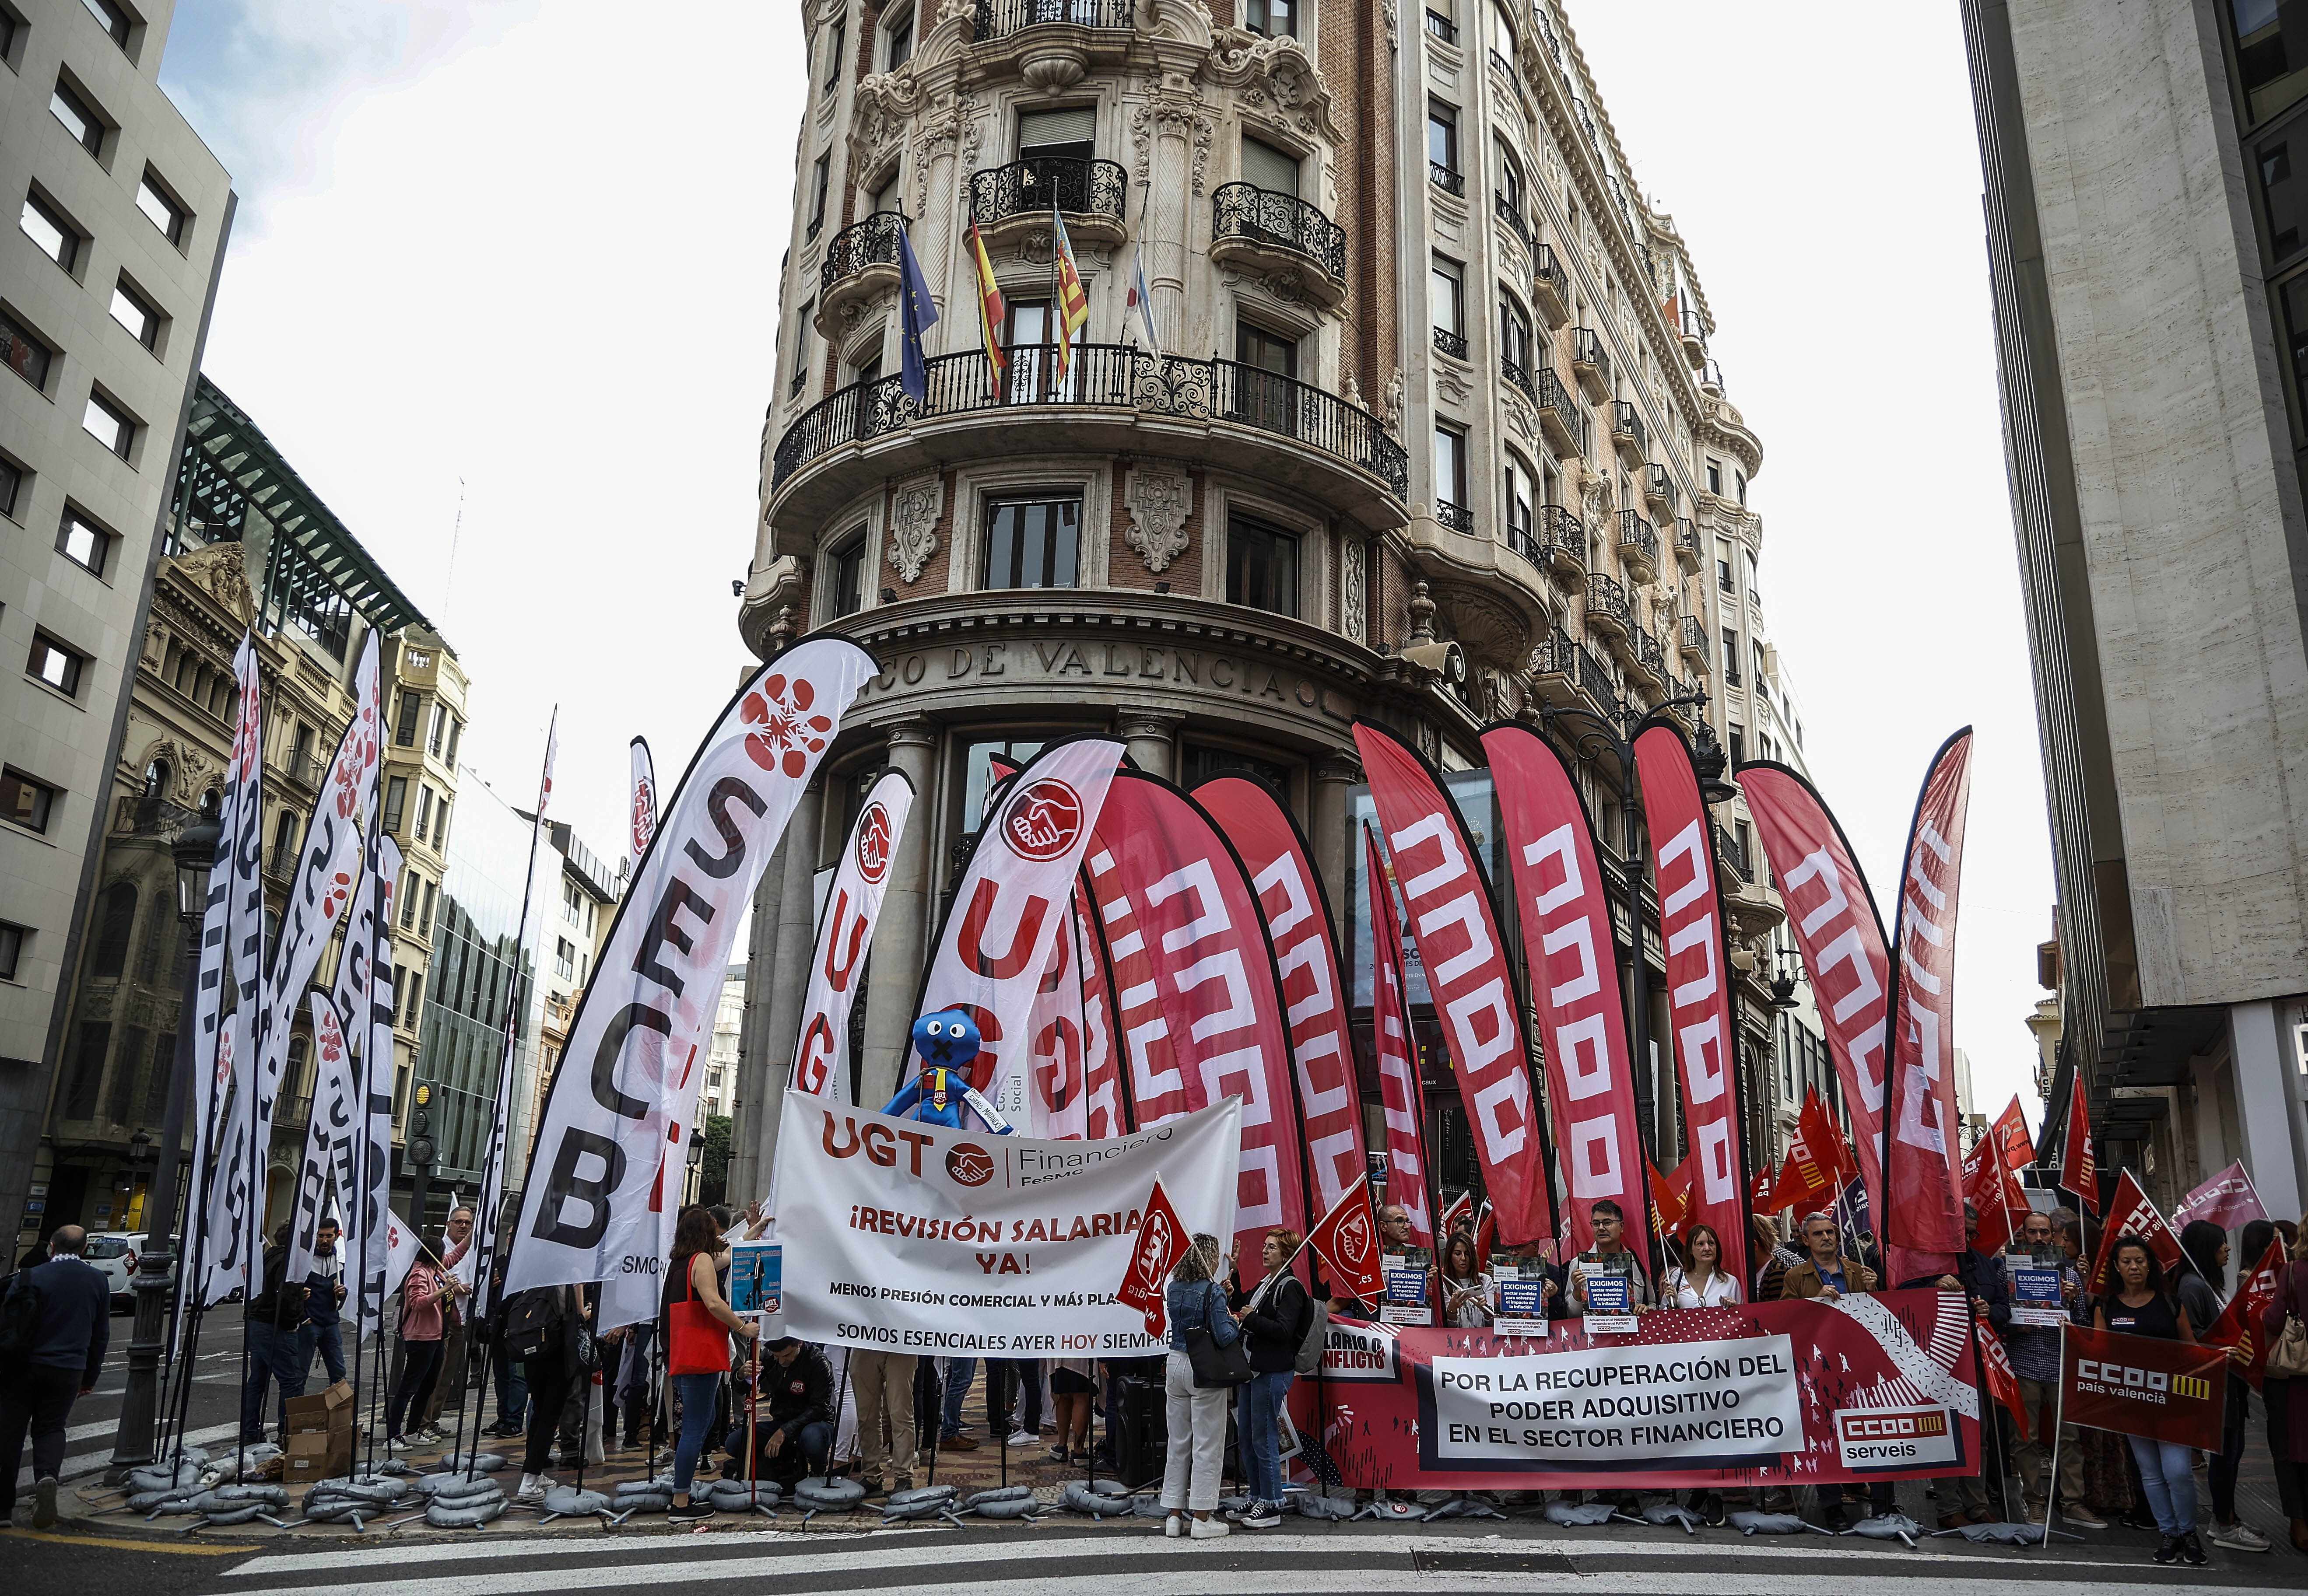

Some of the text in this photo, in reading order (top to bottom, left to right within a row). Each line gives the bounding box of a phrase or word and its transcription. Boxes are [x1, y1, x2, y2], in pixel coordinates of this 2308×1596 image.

[947, 642, 1006, 679] DE
[1033, 642, 1286, 700] VALENCIA
[1011, 1076, 1021, 1112] Social
[822, 1110, 934, 1178] UGT
[1020, 1128, 1173, 1170] Financiero
[1021, 1169, 1084, 1186] FeSMC
[849, 1204, 1142, 1243] ¡REVISIÓN SALARIA
[975, 1253, 1031, 1274] YA!
[829, 1281, 877, 1298] MENOS
[880, 1290, 945, 1306] PRESIÓN
[949, 1294, 1036, 1307] COMERCIAL
[1040, 1294, 1051, 1307] Y
[1054, 1291, 1083, 1307] MÁS
[837, 1323, 898, 1344] SOMOS
[904, 1330, 1007, 1350] ESENCIALES
[1011, 1335, 1055, 1350] AYER
[1061, 1334, 1098, 1350] HOY
[1324, 1331, 1368, 1351] LARIO
[1322, 1351, 1385, 1369] NFLICTO
[1441, 1354, 1787, 1392] POR LA RECUPERACIÓN DEL
[791, 1381, 803, 1390] UGT
[2078, 1358, 2168, 1391] CCOO
[1490, 1389, 1740, 1420] PODER ADQUISITIVO
[2077, 1380, 2166, 1405] país valencià
[1449, 1416, 1784, 1448] EN EL SECTOR FINANCIERO
[1846, 1418, 1915, 1436] CCOO
[1846, 1442, 1916, 1459] serveis
